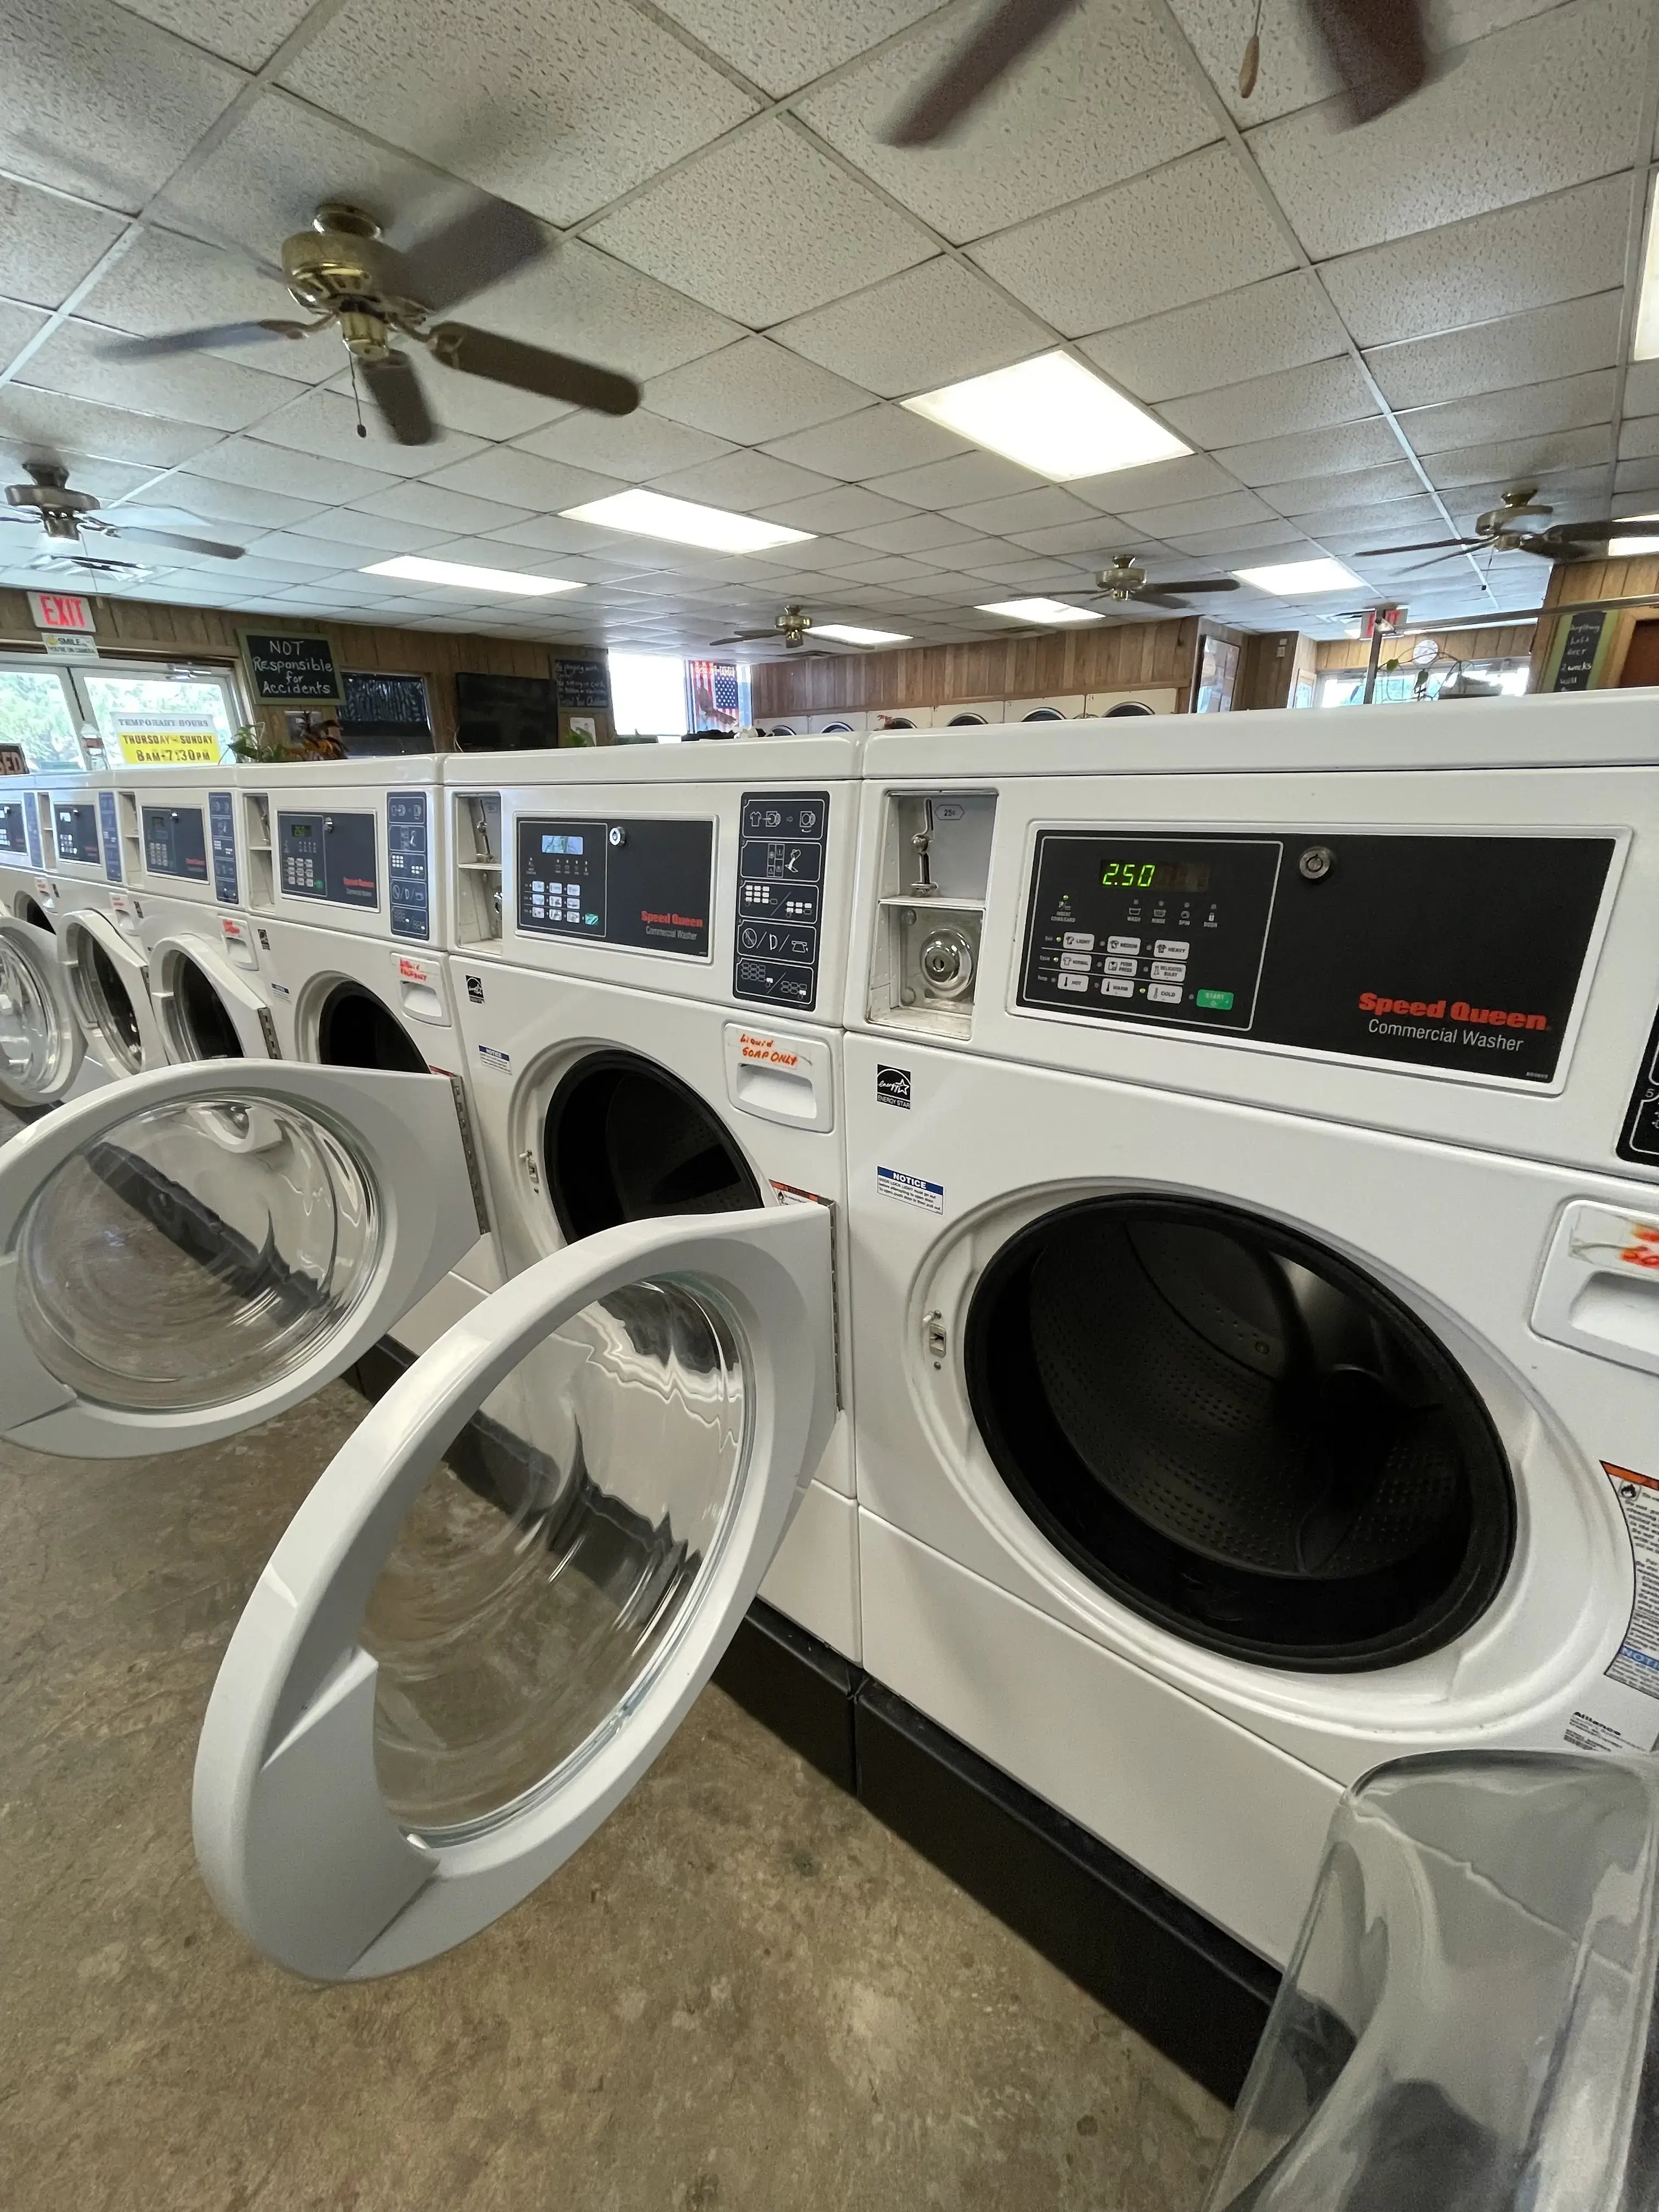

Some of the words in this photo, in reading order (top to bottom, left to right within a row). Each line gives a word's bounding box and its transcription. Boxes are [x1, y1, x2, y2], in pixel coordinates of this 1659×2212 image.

[39, 595, 84, 627] EXIT
[269, 640, 304, 656] NOT
[1567, 662, 1592, 671] weeks
[286, 670, 303, 684] for
[263, 681, 331, 695] Accidents
[122, 735, 170, 744] THURSDAY
[180, 735, 212, 744] SUNDAY
[1103, 864, 1155, 887] 2.50
[641, 911, 671, 924] Speed
[672, 913, 703, 927] Queen
[646, 926, 676, 938] Commercial
[677, 930, 697, 940] Washer
[1358, 992, 1447, 1018] Speed
[1450, 1002, 1547, 1030] Queen
[1368, 1019, 1458, 1043] Commercial
[1463, 1029, 1524, 1052] Washer
[742, 1047, 769, 1059] SOAP
[771, 1052, 797, 1065] ONLY
[1645, 1088, 1655, 1098] 5
[878, 1095, 896, 1105] ENERGY
[896, 1100, 910, 1108] STAR
[893, 1172, 927, 1189] NOTICE
